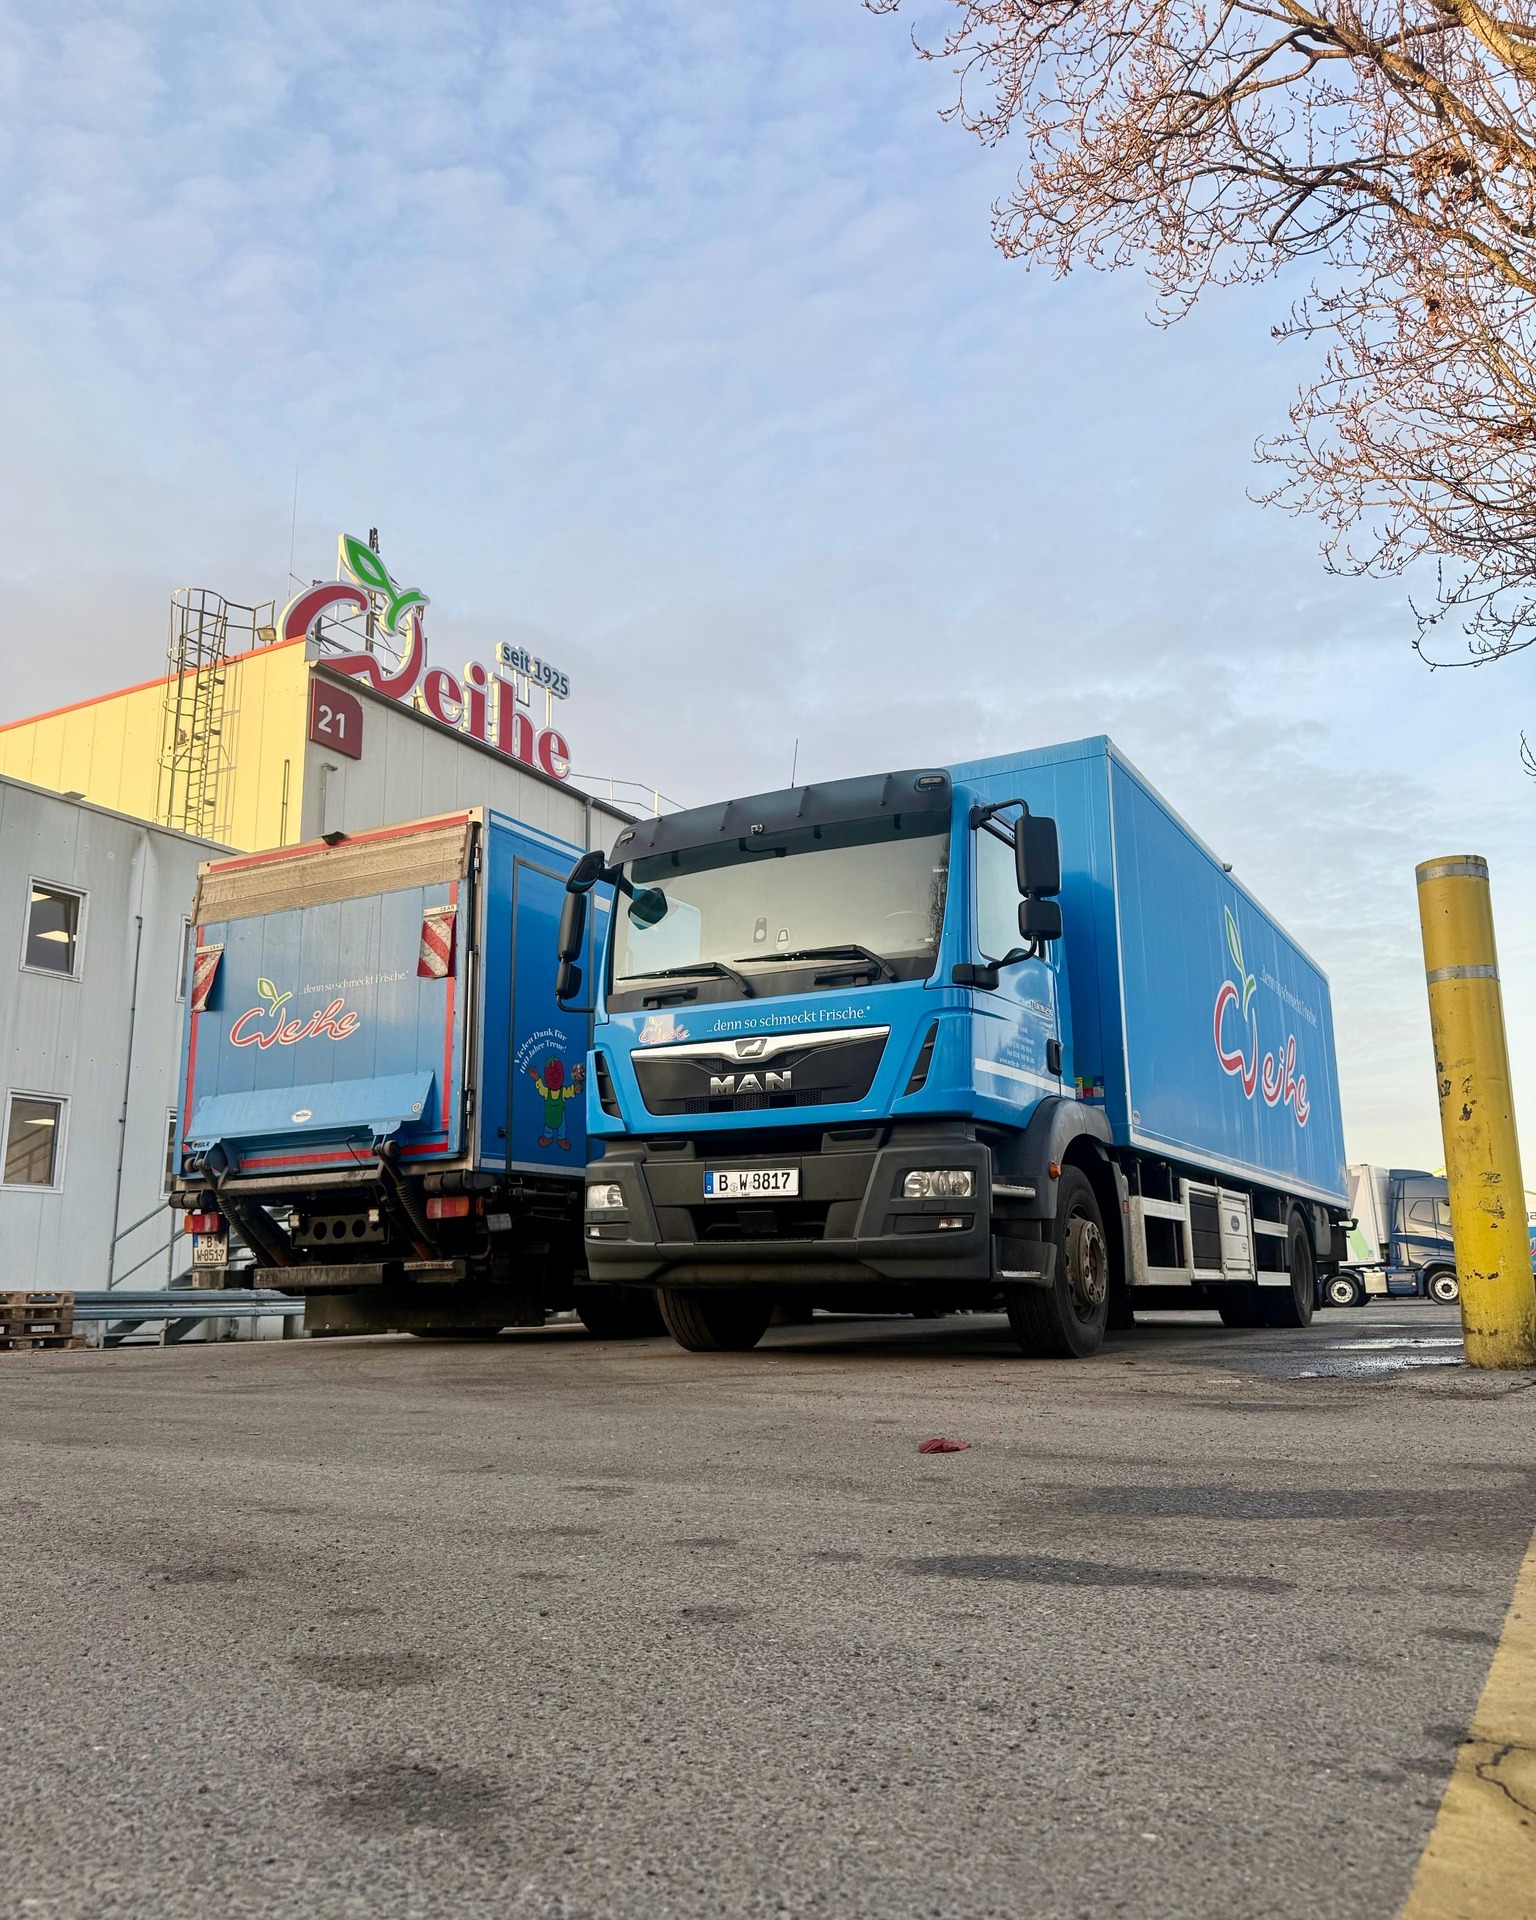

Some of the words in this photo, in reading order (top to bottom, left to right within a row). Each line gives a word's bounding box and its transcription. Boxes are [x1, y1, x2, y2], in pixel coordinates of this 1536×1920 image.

[503, 646, 530, 673] seit
[534, 660, 568, 695] 1925
[318, 705, 345, 739] 21
[324, 983, 334, 991] so
[335, 975, 374, 989] schmeckt
[229, 997, 361, 1050] Weihe
[744, 1018, 757, 1029] so
[759, 1011, 817, 1027] schmeckt
[514, 1037, 534, 1064] Vielen
[533, 1028, 553, 1040] Dank
[554, 1029, 567, 1041] für
[528, 1042, 545, 1058] Jahre
[1213, 980, 1310, 1128] Weihe
[710, 1071, 792, 1095] MAN
[719, 1174, 728, 1191] B
